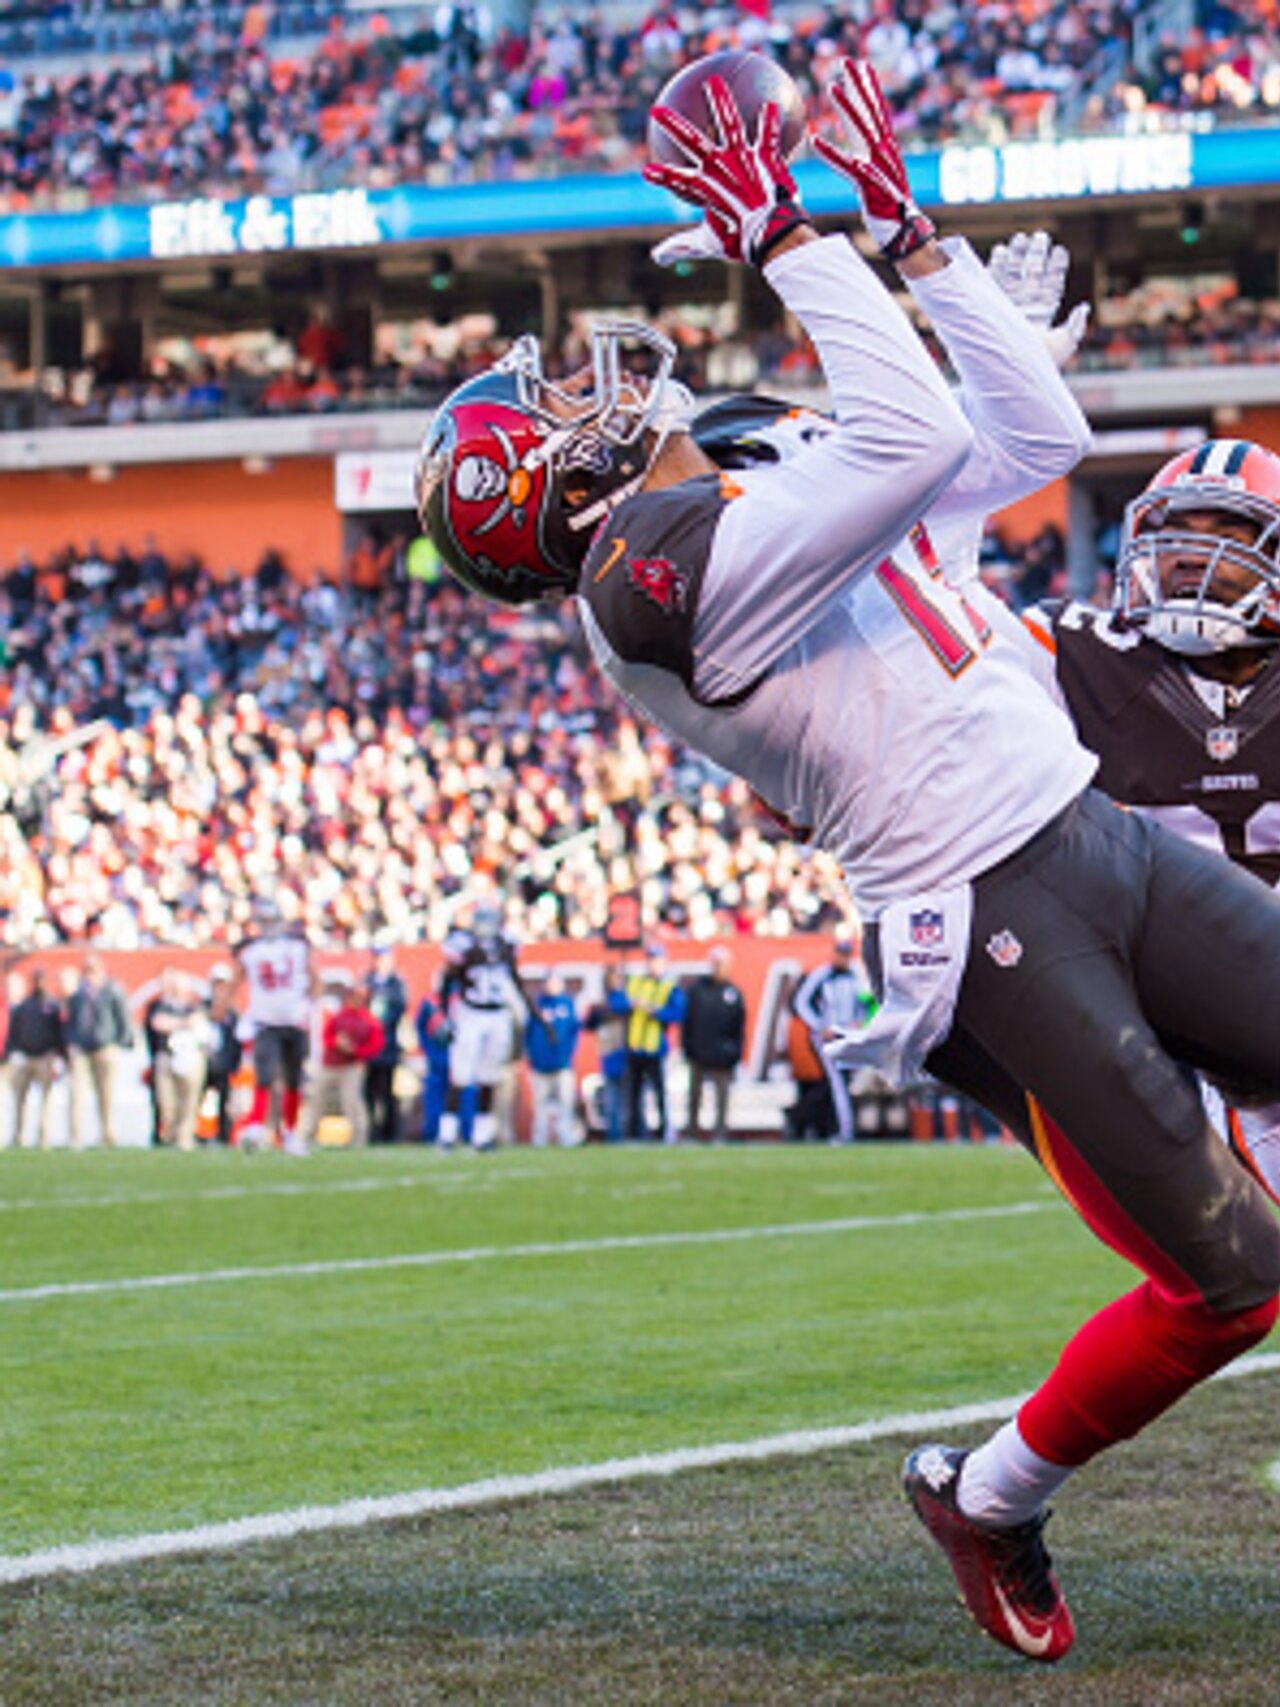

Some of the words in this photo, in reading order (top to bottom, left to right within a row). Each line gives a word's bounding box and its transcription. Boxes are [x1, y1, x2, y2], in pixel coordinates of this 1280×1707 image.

[940, 146, 997, 204] GO
[150, 198, 236, 259] Elk
[241, 196, 288, 250] &
[293, 188, 381, 248] Elk
